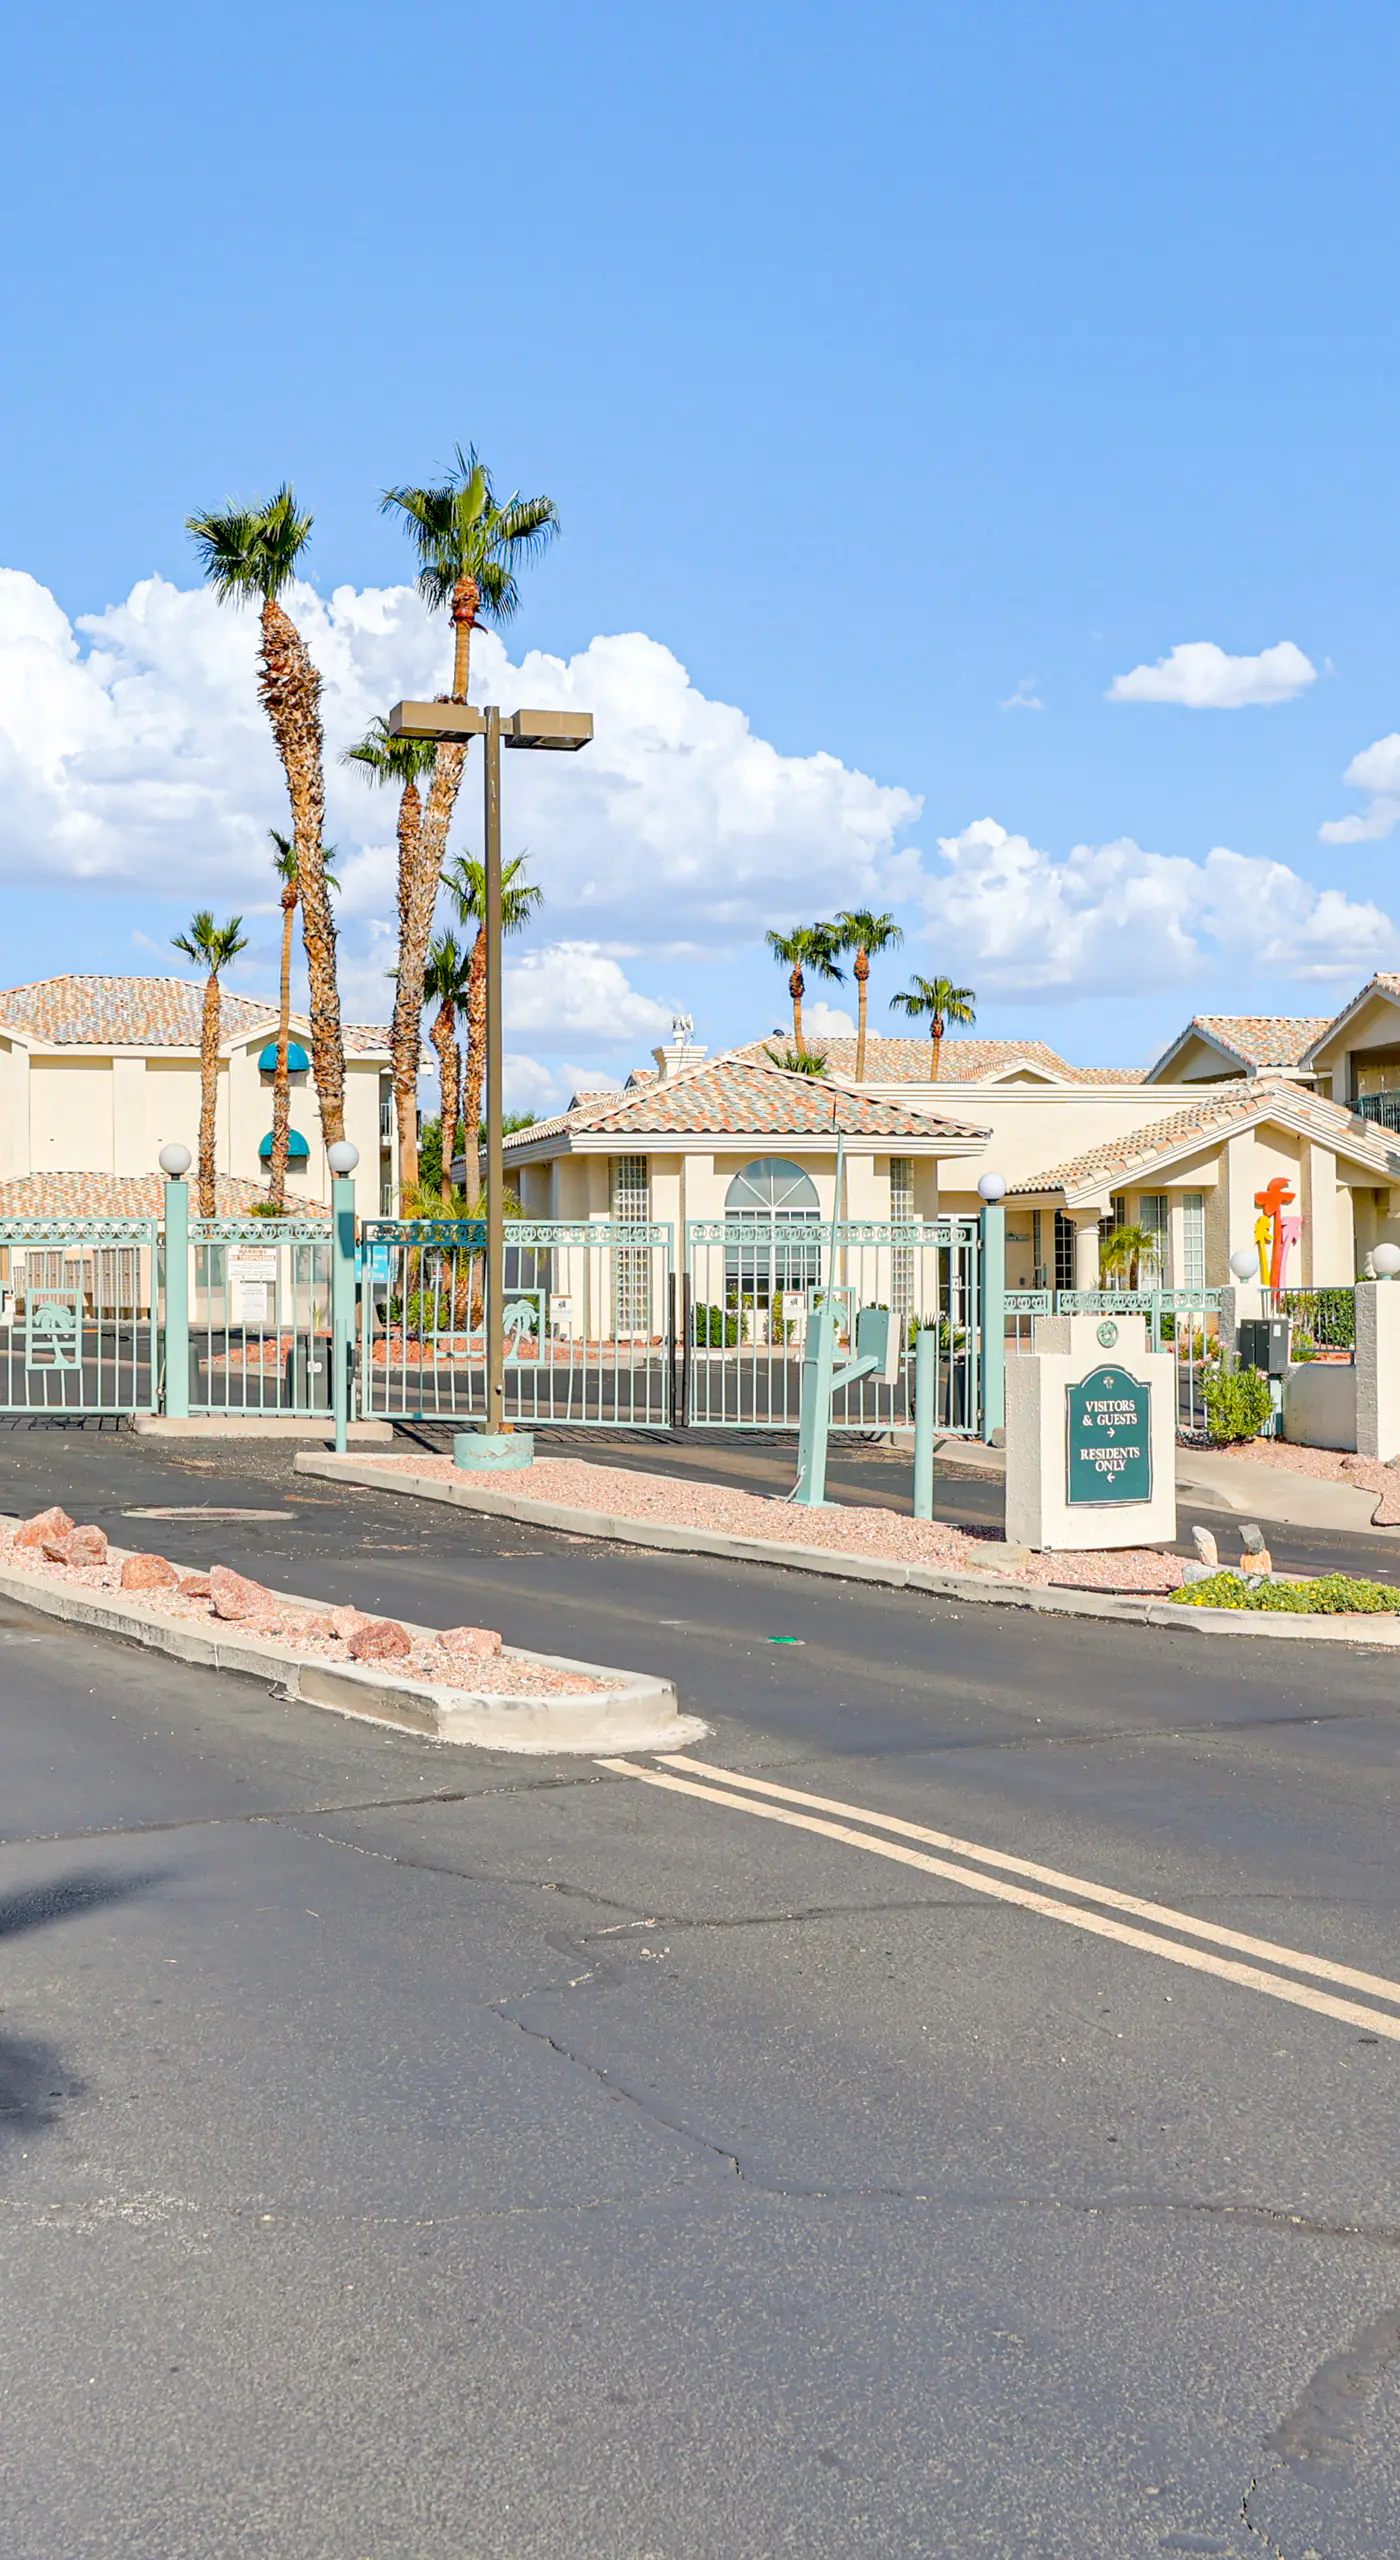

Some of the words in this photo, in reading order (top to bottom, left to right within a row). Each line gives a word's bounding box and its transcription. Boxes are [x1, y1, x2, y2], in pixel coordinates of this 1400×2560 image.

[1085, 1399, 1136, 1413] VISITORS
[1082, 1414, 1094, 1427] &
[1096, 1413, 1138, 1426] GUESTS
[1080, 1446, 1140, 1461] RESIDENTS
[1095, 1459, 1127, 1472] ONLY
